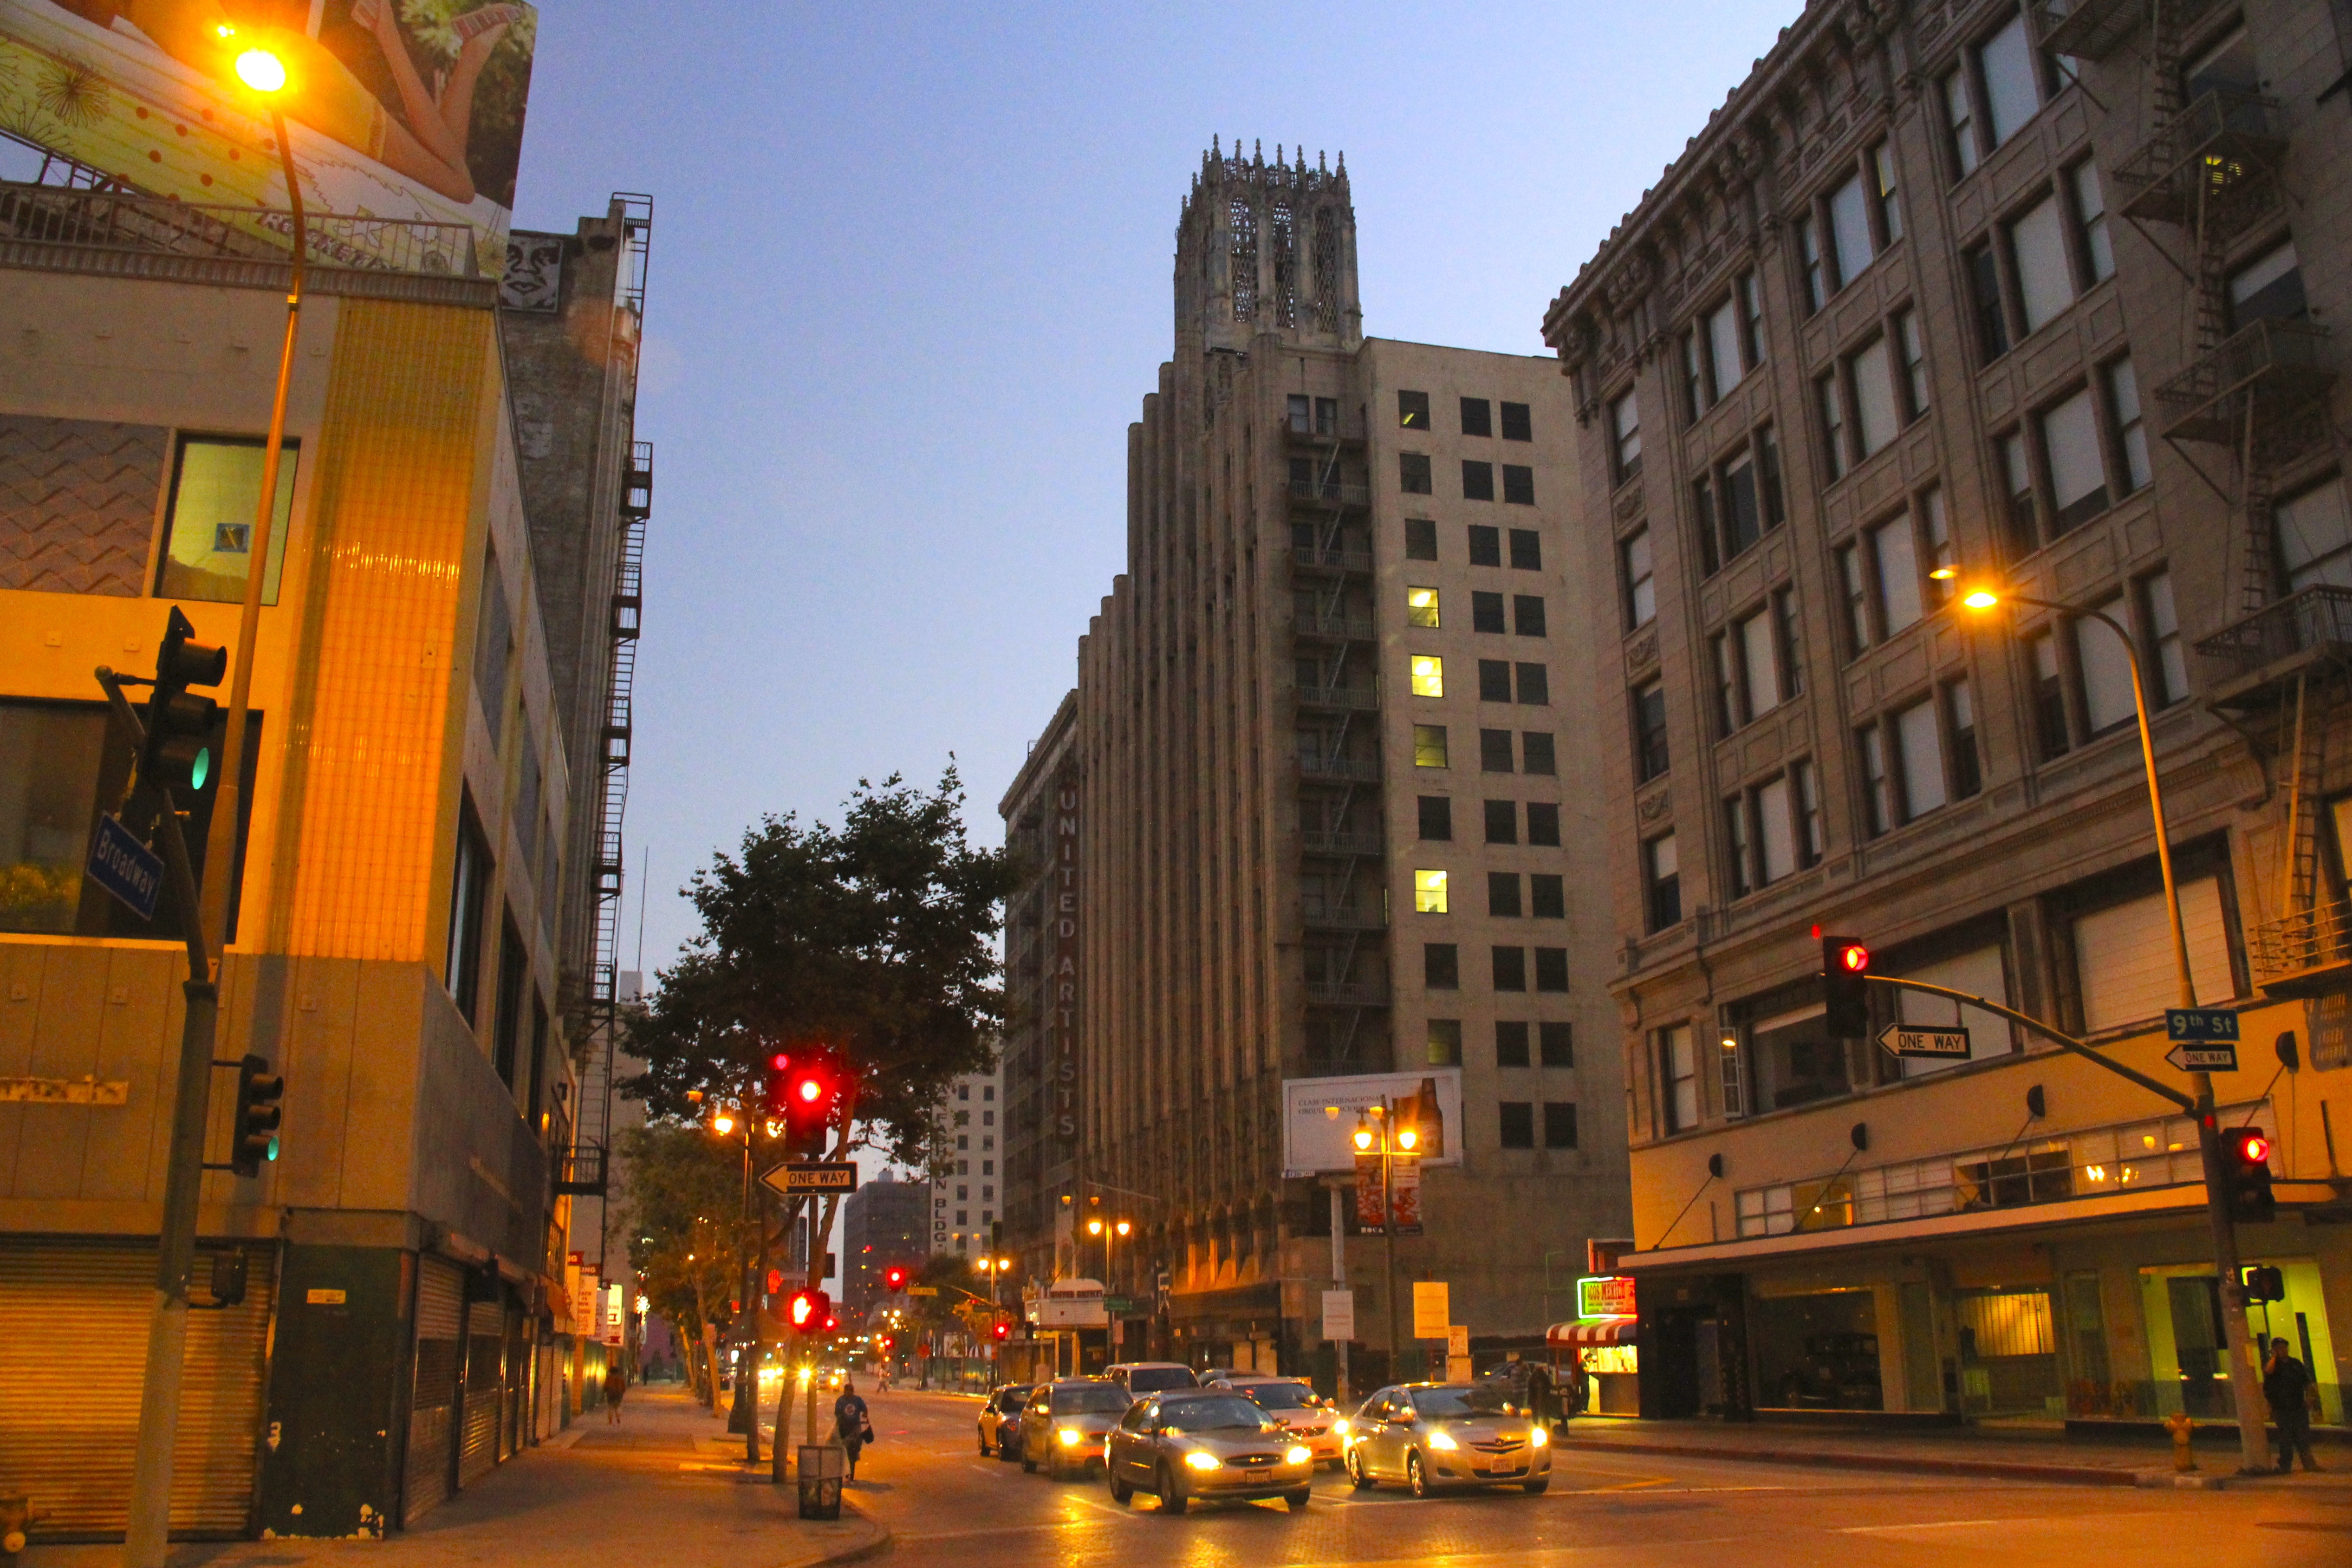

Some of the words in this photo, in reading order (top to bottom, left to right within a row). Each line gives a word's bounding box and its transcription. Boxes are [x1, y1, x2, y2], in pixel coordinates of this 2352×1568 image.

[97, 829, 156, 904] Broadway
[1059, 790, 1076, 937] UNITED
[2173, 1015, 2204, 1035] 9th
[2212, 1016, 2232, 1033] St
[1059, 956, 1075, 1135] ARTISTS
[1898, 1034, 1925, 1049] ONE
[1934, 1035, 1961, 1050] WAY
[2186, 1053, 2205, 1063] ONE
[2208, 1052, 2228, 1063] WAY
[1323, 1096, 1381, 1104] INTERNACIONA
[789, 1173, 815, 1184] ONE
[820, 1172, 846, 1184] WAY
[1584, 1283, 1600, 1300] TACOS
[1602, 1282, 1625, 1300] MEXICO
